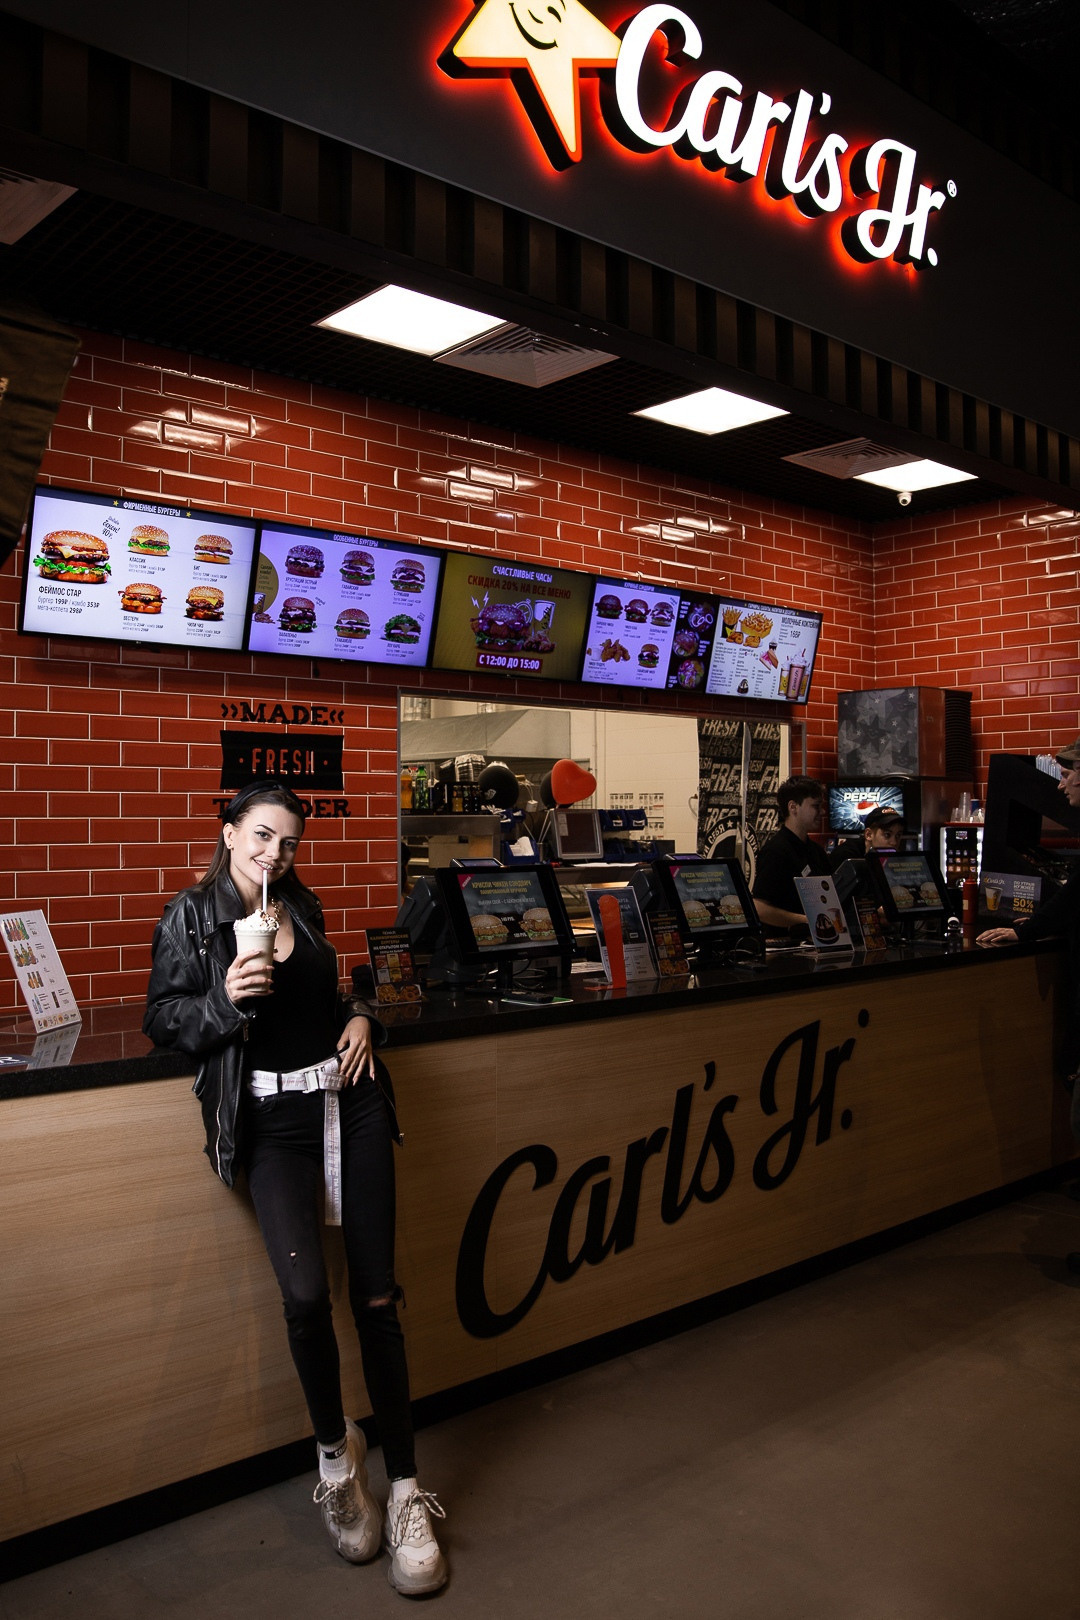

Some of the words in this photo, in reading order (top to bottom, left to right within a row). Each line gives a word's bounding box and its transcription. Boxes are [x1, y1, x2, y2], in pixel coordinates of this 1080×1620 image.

[615, 3, 848, 213] Carl's
[856, 138, 945, 266] Jr.
[123, 501, 157, 513] ФИРМЕННЫЕ
[157, 506, 181, 517] БУРГЕРЫ
[333, 533, 359, 545] ОСОБЕННЫЕ
[359, 536, 379, 548] БУРГЕРЫ
[492, 565, 534, 580] СЧАСТЛИВЫЕ
[535, 572, 552, 583] ЧАСЫ
[38, 585, 65, 596] ФЕЙМОС
[66, 588, 82, 597] СТАР
[467, 575, 500, 589] СКИДКА
[502, 582, 518, 592] 20%
[520, 584, 530, 594] НА
[532, 586, 546, 596] ВСЕ
[547, 587, 571, 599] МЕНЮ
[37, 596, 54, 604] бургер
[37, 605, 69, 613] мега-котлета
[781, 616, 801, 627] МОЛОЧНЫЕ
[479, 654, 485, 664] С
[486, 655, 506, 667] 12:00
[507, 657, 518, 669] ДО
[520, 658, 540, 669] 15:00
[240, 702, 329, 726] MADE
[252, 748, 315, 775] FRESH
[843, 791, 881, 802] PEPSI
[708, 823, 726, 842] СЕБЯ
[1013, 897, 1034, 909] 50%
[327, 1126, 339, 1176] WHITE
[455, 1060, 739, 1339] Carl's
[752, 1019, 856, 1191] Jr.
